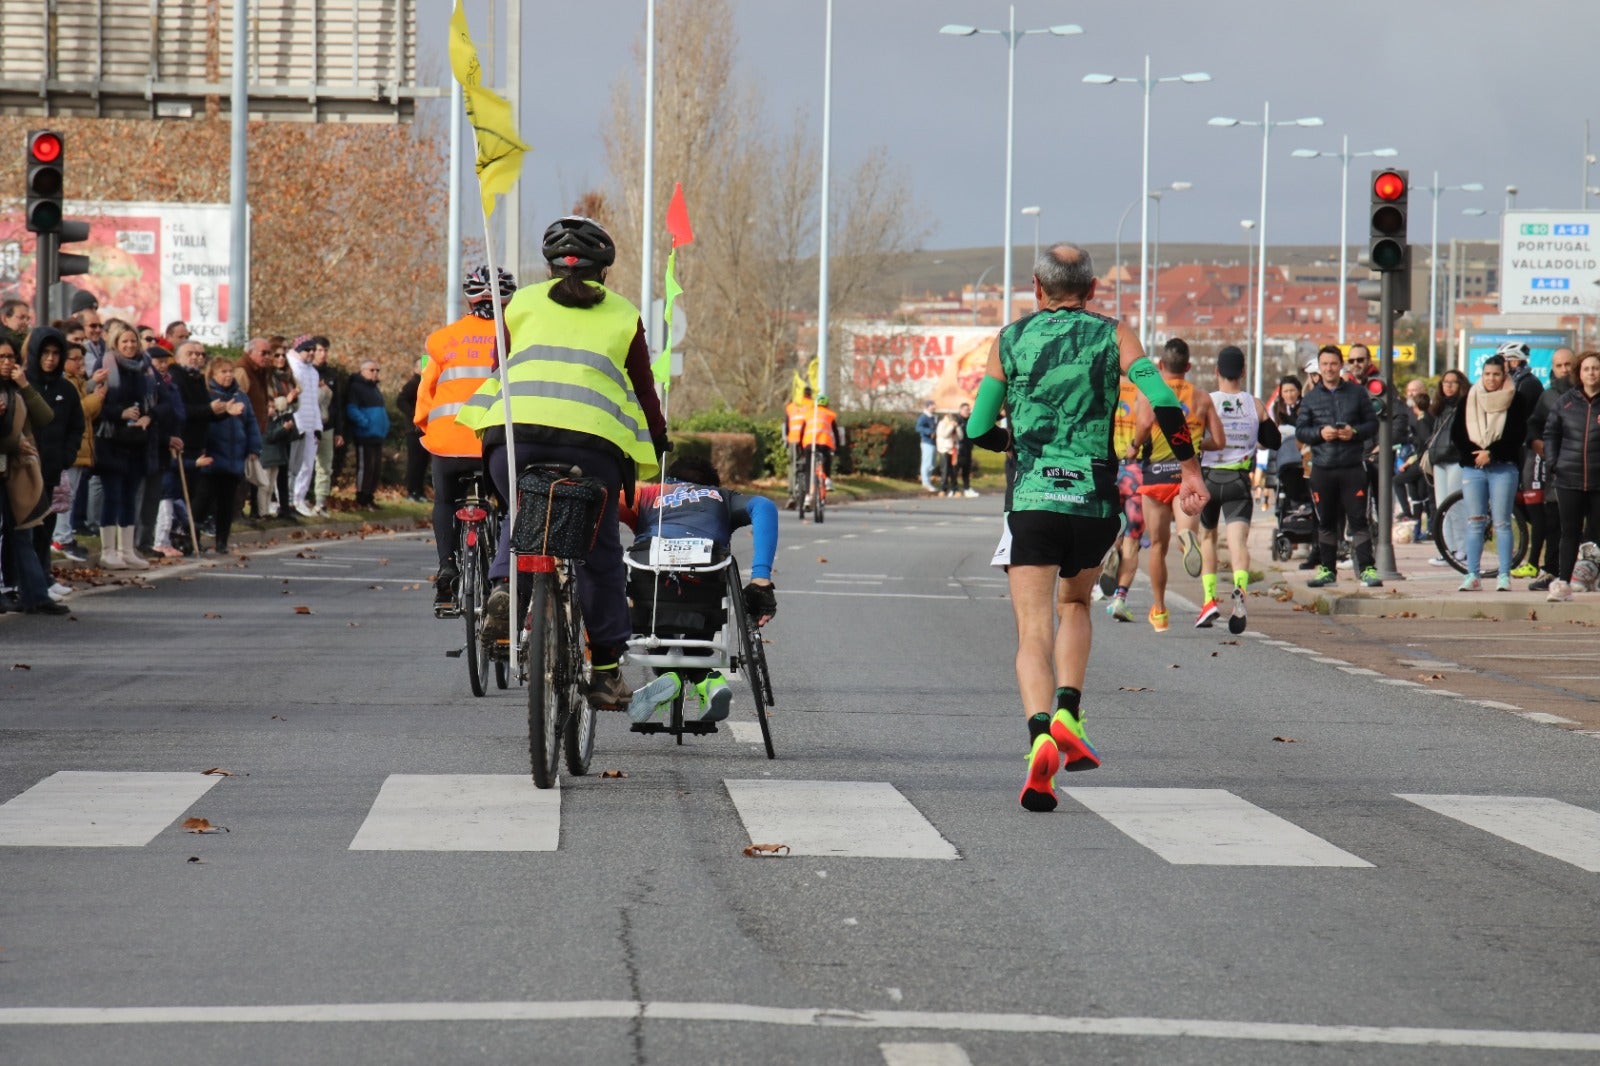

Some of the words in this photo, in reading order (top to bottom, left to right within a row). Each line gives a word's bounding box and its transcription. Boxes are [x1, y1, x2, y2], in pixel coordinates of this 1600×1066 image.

[1517, 241, 1591, 252] PORTUGAL
[172, 263, 231, 276] CAPUCHIN
[1511, 259, 1597, 270] VALLADOLID
[1522, 296, 1580, 306] ZAMORA
[189, 324, 222, 337] KFC
[1044, 492, 1085, 505] SALAMANCA
